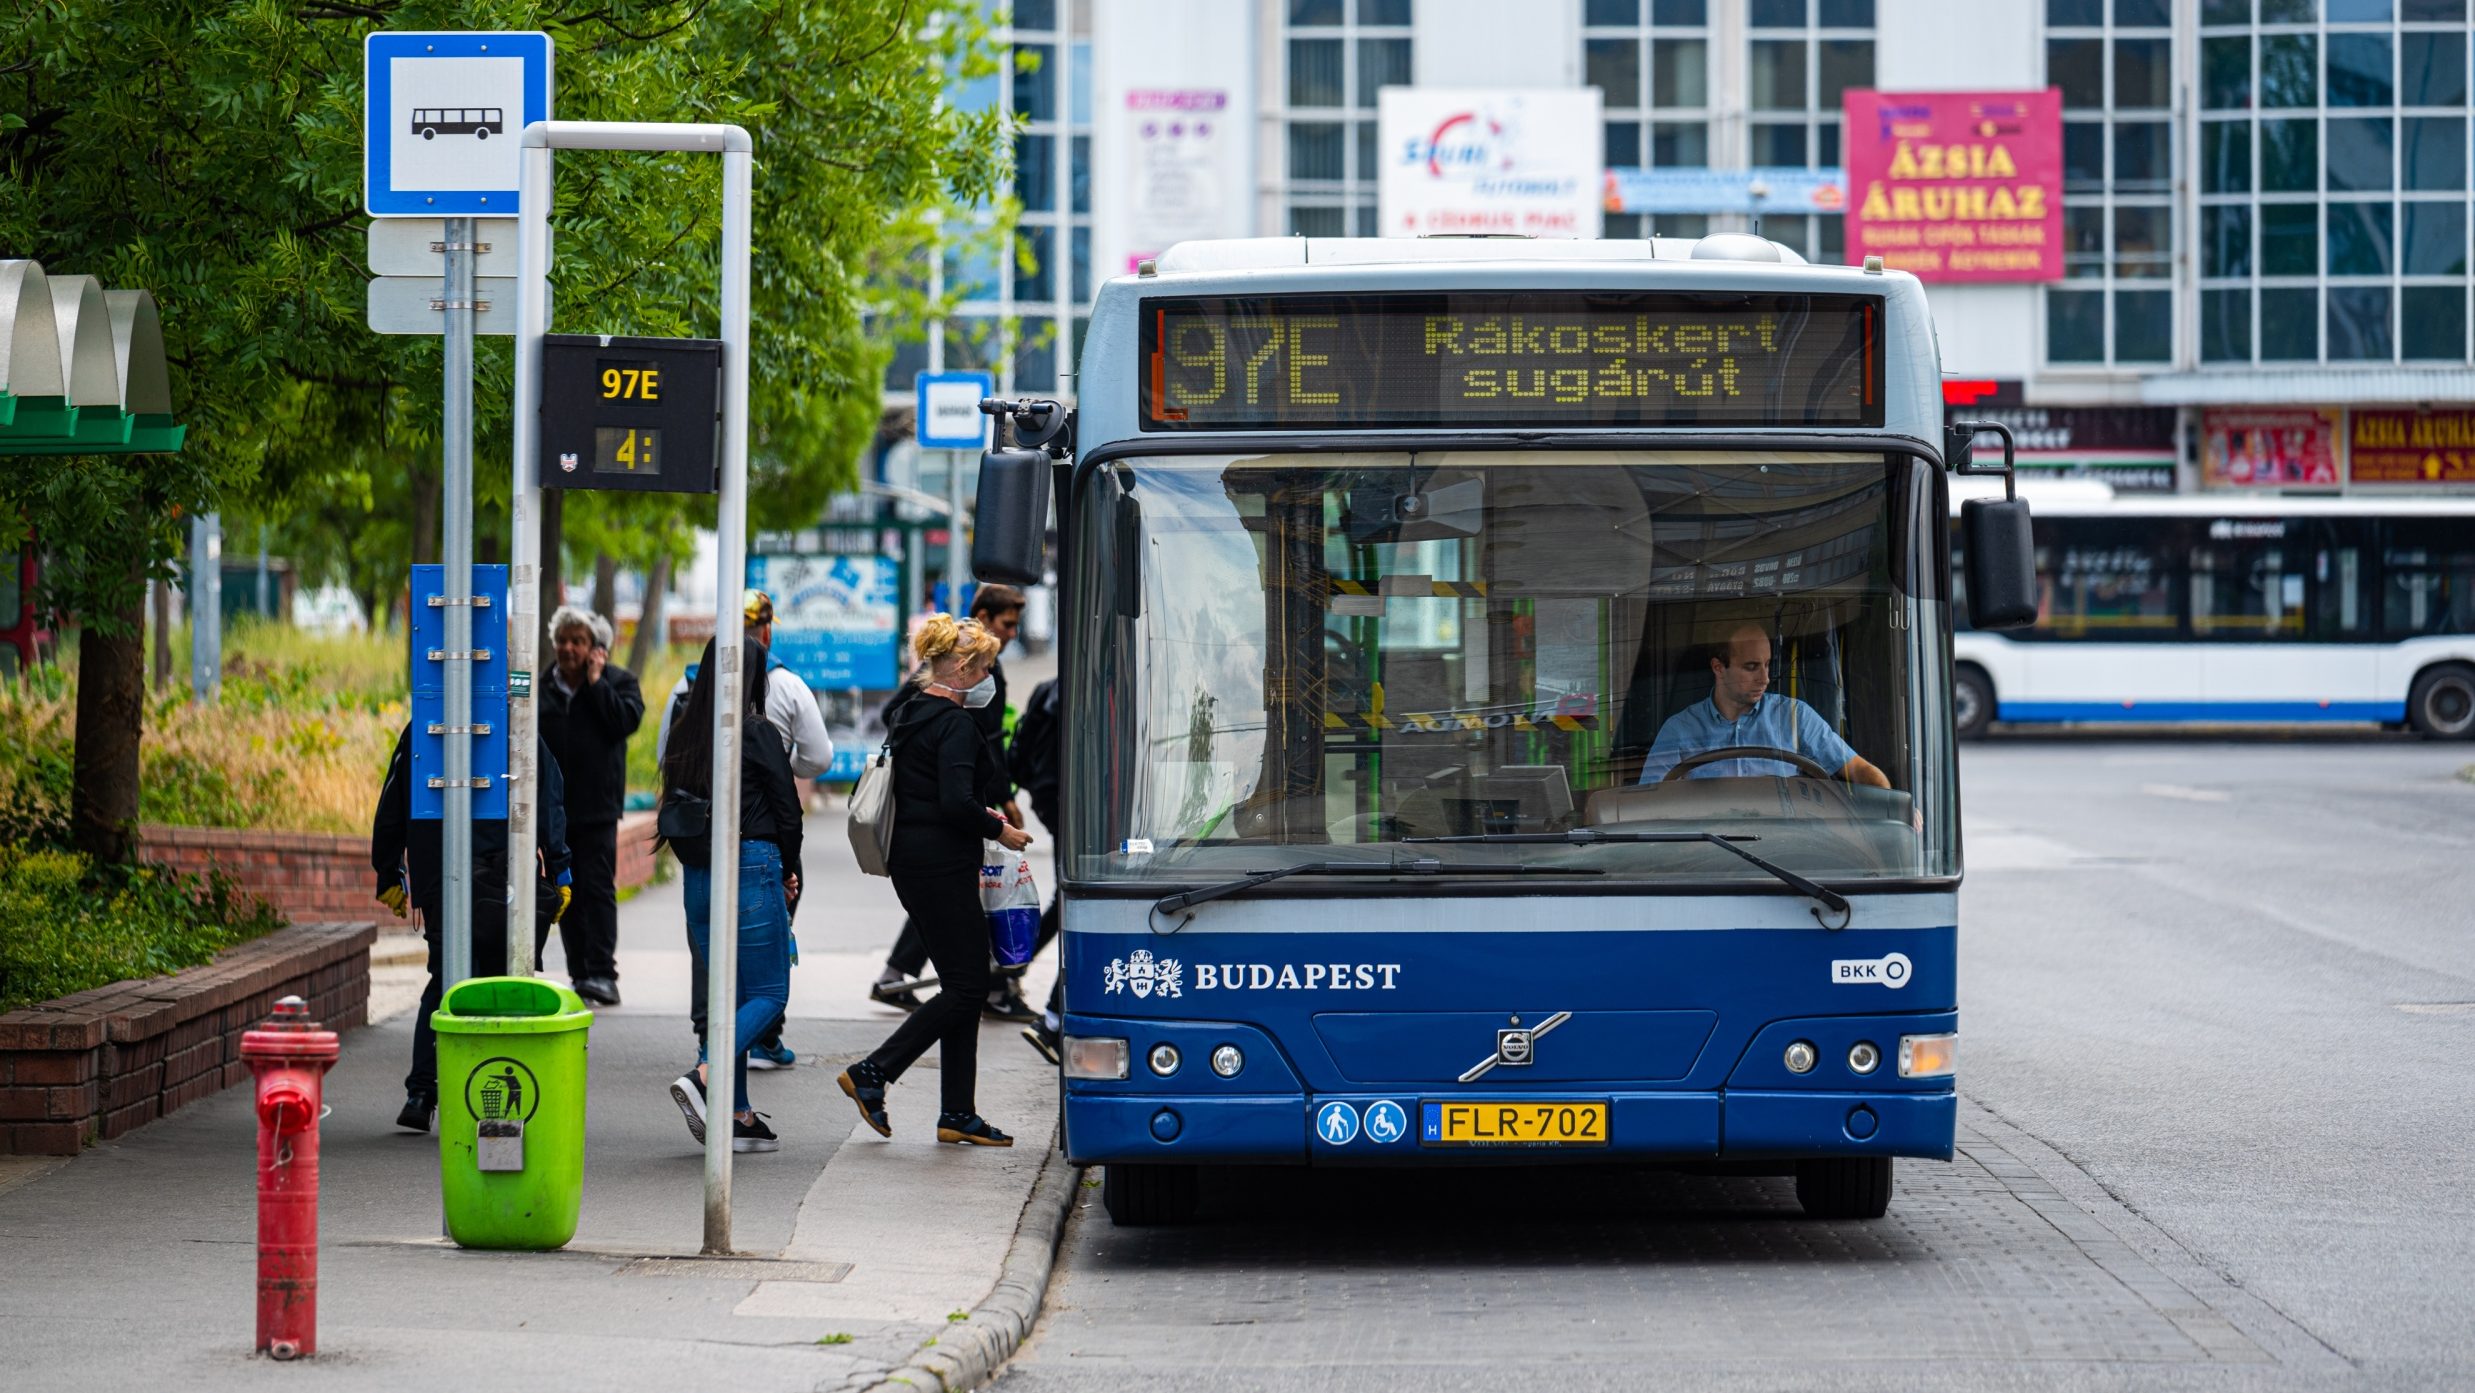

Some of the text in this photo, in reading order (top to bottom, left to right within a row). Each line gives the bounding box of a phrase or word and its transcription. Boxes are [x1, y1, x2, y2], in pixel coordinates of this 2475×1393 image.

[1888, 138, 2017, 180] ÁZSIA
[1425, 314, 1778, 354] Rákoskert
[1171, 317, 1340, 404] 97E
[602, 368, 658, 400] 97E
[1463, 358, 1740, 403] sugárút
[1195, 964, 1401, 990] BUDAPEST
[1840, 965, 1877, 978] BKK
[1428, 1125, 1437, 1136] H
[1449, 1108, 1598, 1137] FLR-702
